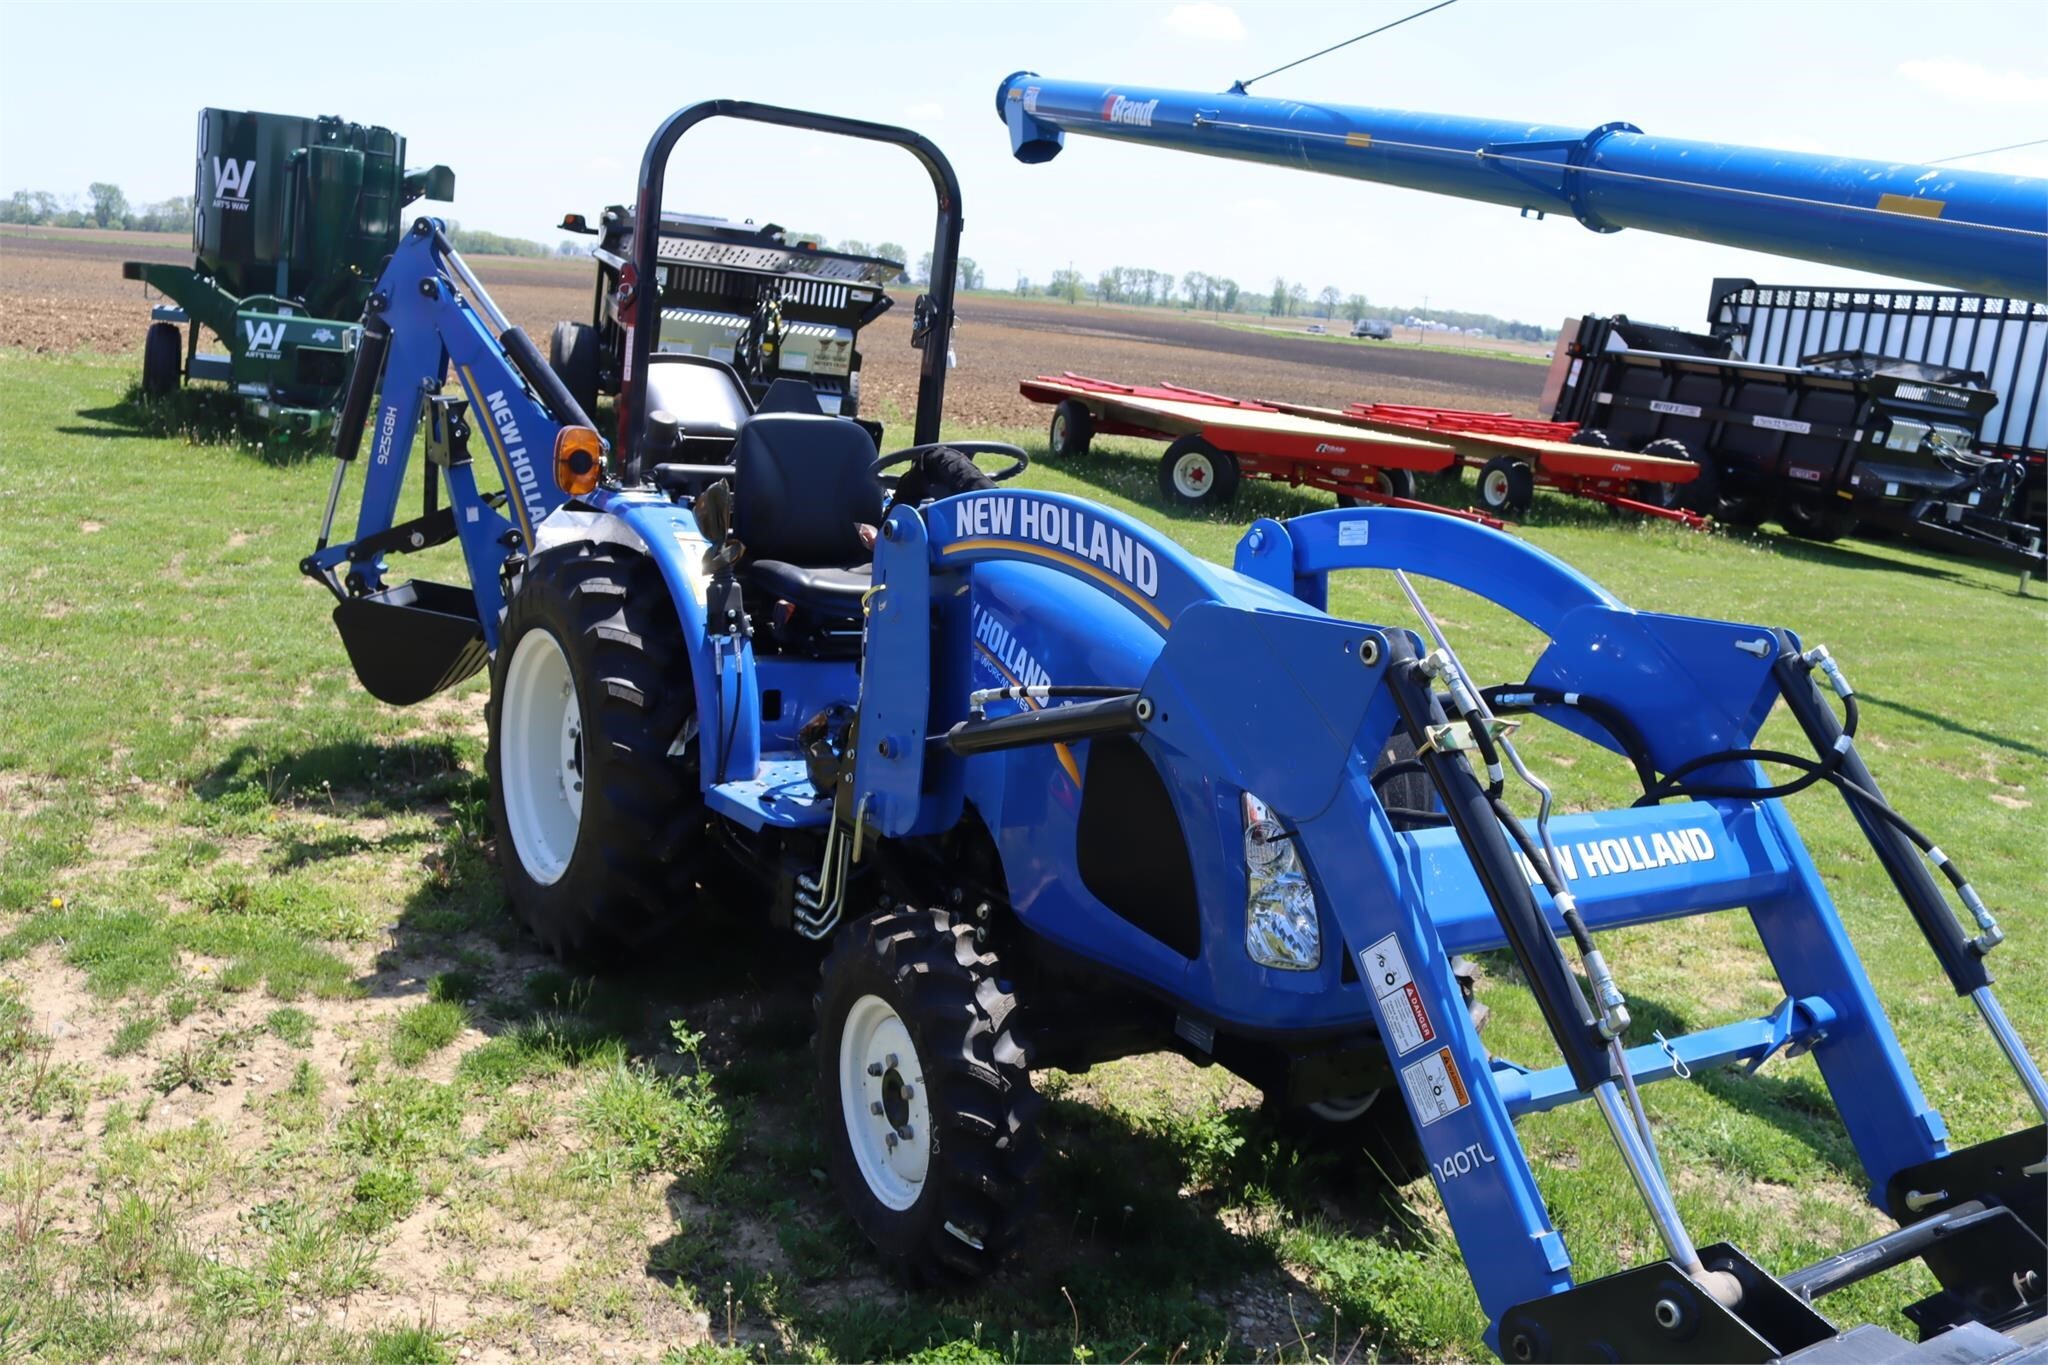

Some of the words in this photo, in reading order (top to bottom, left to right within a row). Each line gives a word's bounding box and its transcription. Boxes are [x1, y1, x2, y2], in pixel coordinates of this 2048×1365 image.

[1110, 95, 1159, 127] Brandt
[231, 201, 250, 212] WAY
[265, 351, 281, 360] WAY
[377, 406, 398, 466] 925GBH
[486, 390, 523, 445] NEW
[956, 496, 1014, 539] NEW
[1020, 498, 1158, 598] HOLLAND
[976, 609, 1052, 708] HOLLAND
[1576, 826, 1716, 879] HOLLAND
[1410, 996, 1431, 1037] DANGER
